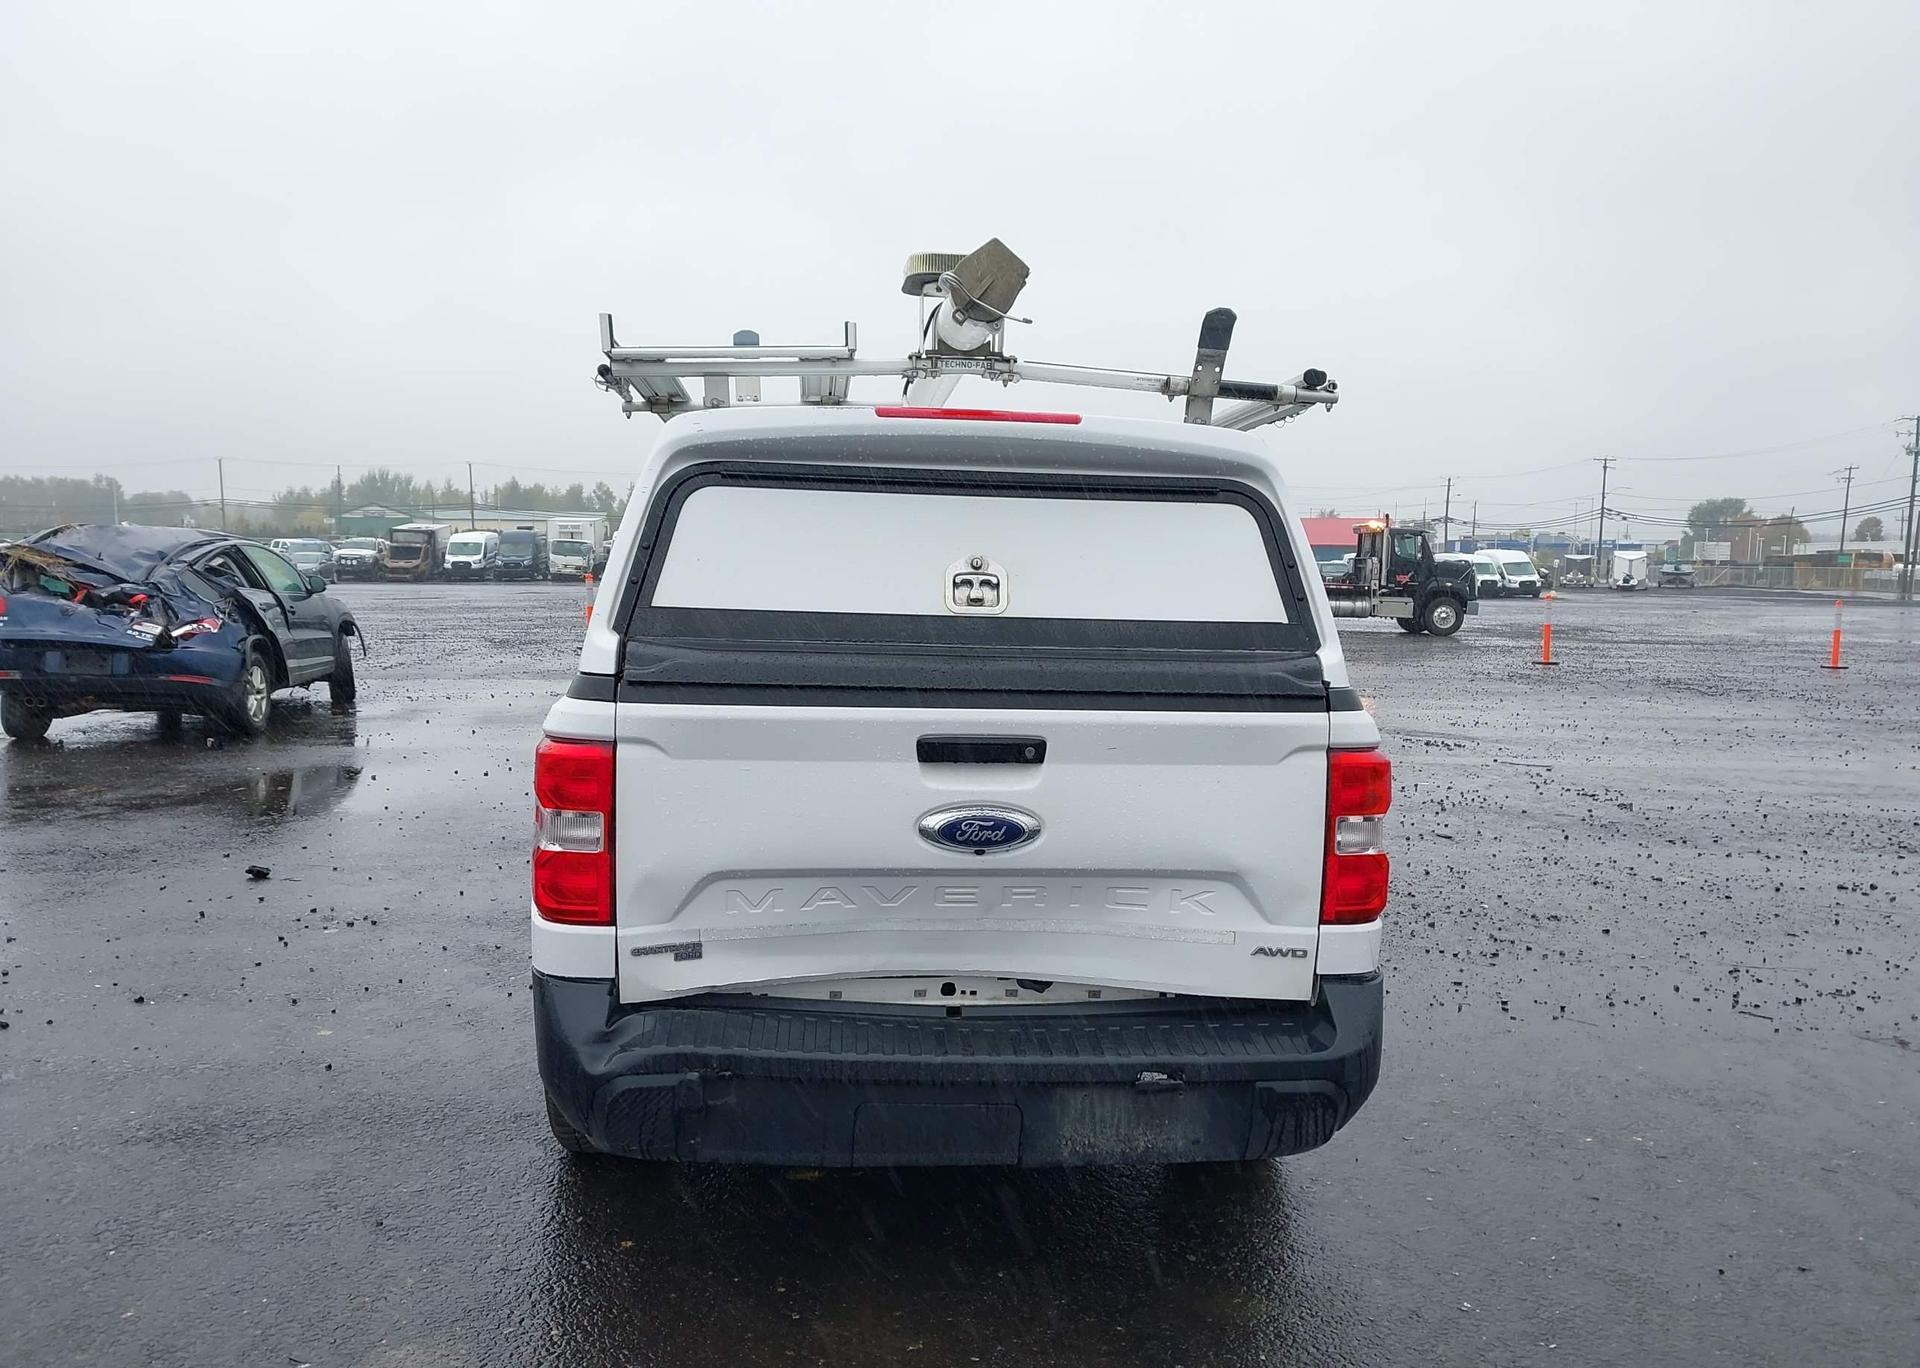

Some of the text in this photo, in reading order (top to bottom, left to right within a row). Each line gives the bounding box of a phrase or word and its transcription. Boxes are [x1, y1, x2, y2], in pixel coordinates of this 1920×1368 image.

[940, 360, 993, 370] TECHNO-FAB
[956, 820, 1007, 841] Ford
[725, 886, 1217, 916] MAVERICK
[674, 951, 702, 962] FORD
[1250, 946, 1308, 959] AWD
